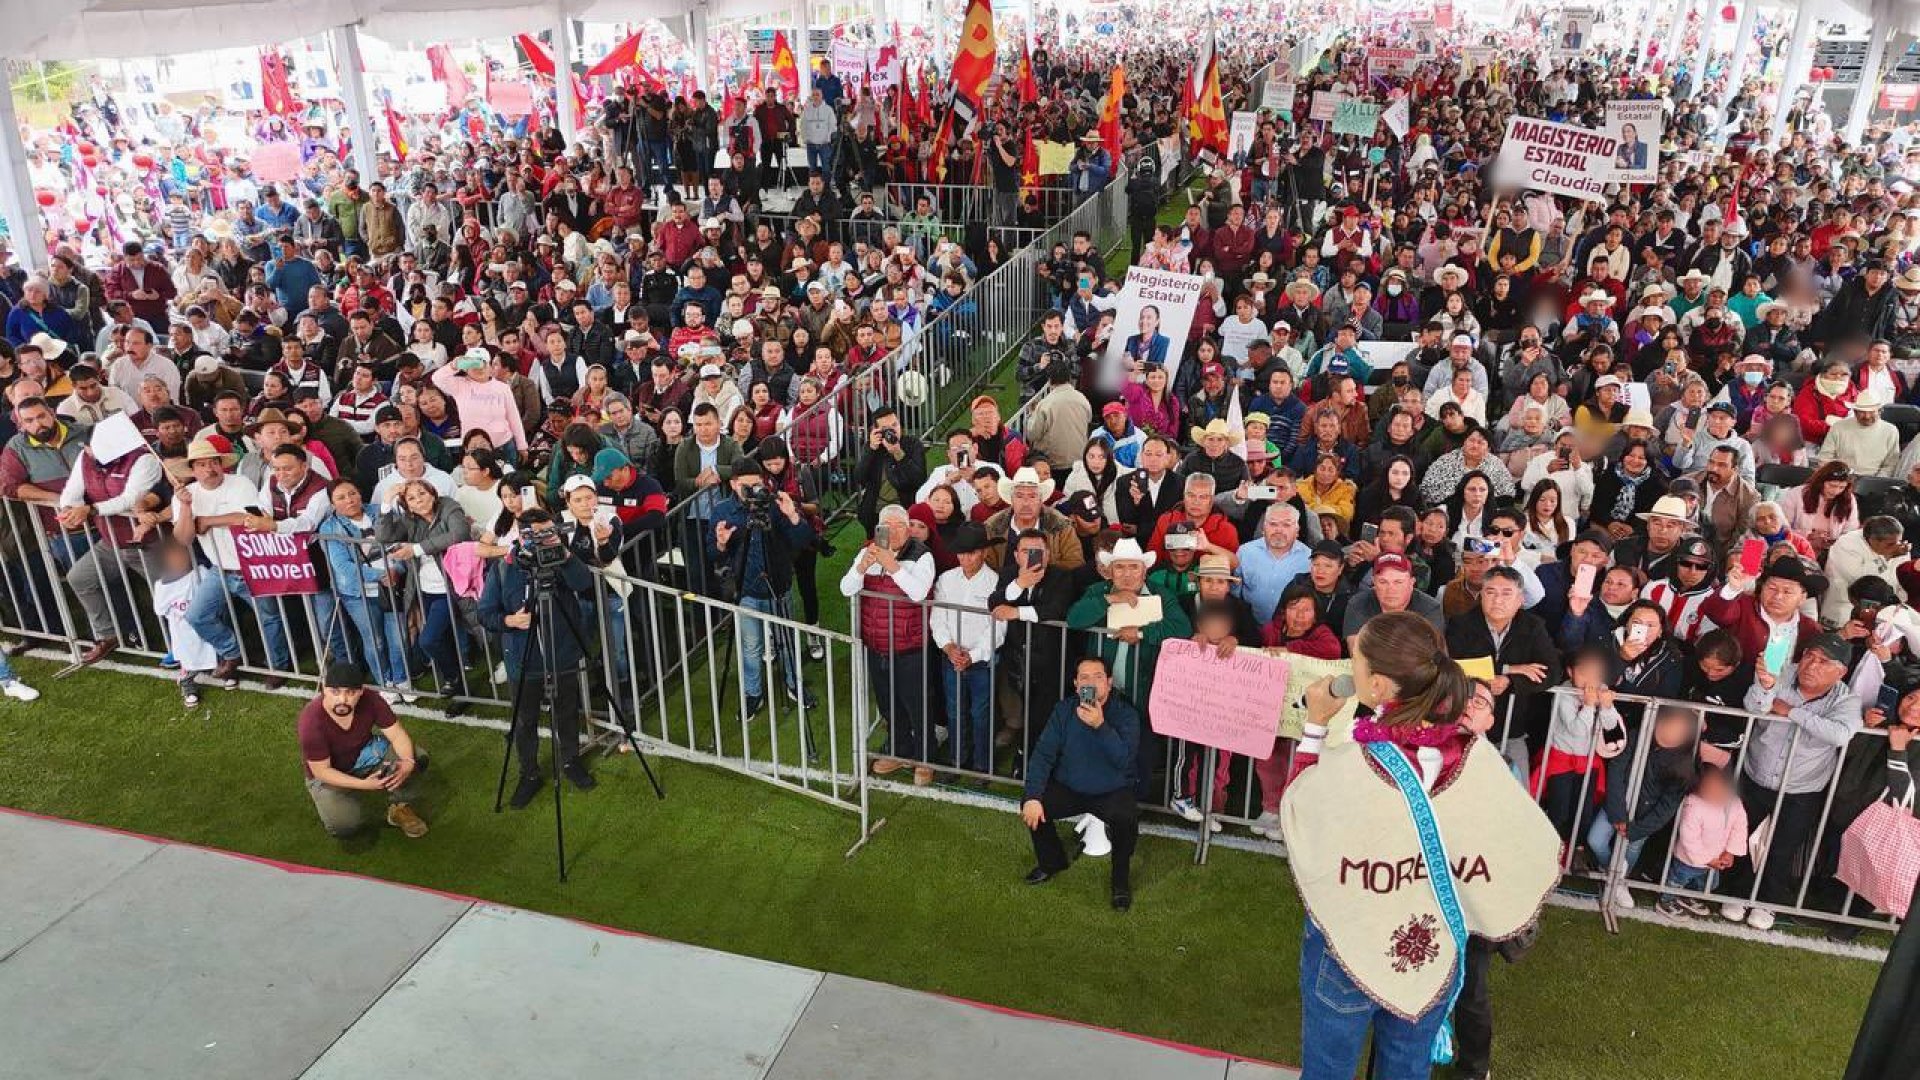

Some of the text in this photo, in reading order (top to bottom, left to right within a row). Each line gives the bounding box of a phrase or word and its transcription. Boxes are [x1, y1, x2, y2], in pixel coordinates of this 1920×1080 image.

[1607, 103, 1661, 113] Magisterio
[1617, 111, 1652, 121] Estatal
[1511, 120, 1618, 158] MAGISTERIO
[1524, 146, 1588, 172] ESTATAL
[1532, 168, 1602, 194] Claudia
[1127, 271, 1200, 292] Magisterio
[1139, 287, 1186, 304] Estatal
[237, 533, 298, 558] SOMOS
